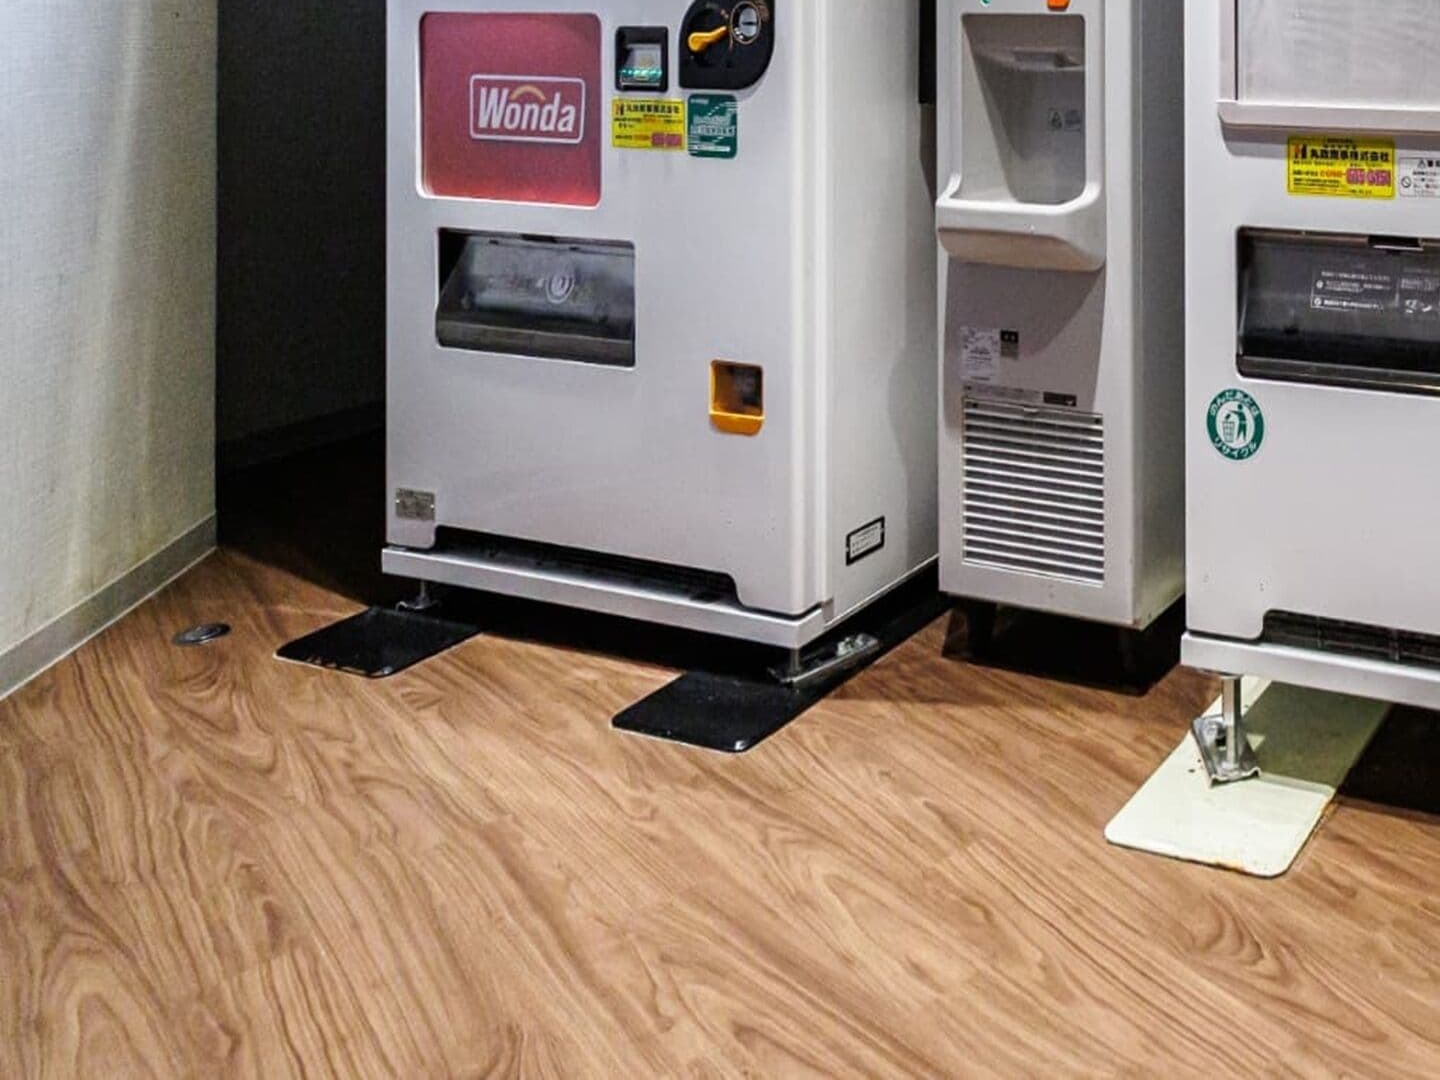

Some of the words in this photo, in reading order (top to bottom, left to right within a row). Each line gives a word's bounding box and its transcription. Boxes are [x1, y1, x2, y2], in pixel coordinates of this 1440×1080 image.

[478, 86, 577, 133] Wonda
[1214, 436, 1257, 458] リサイクル
